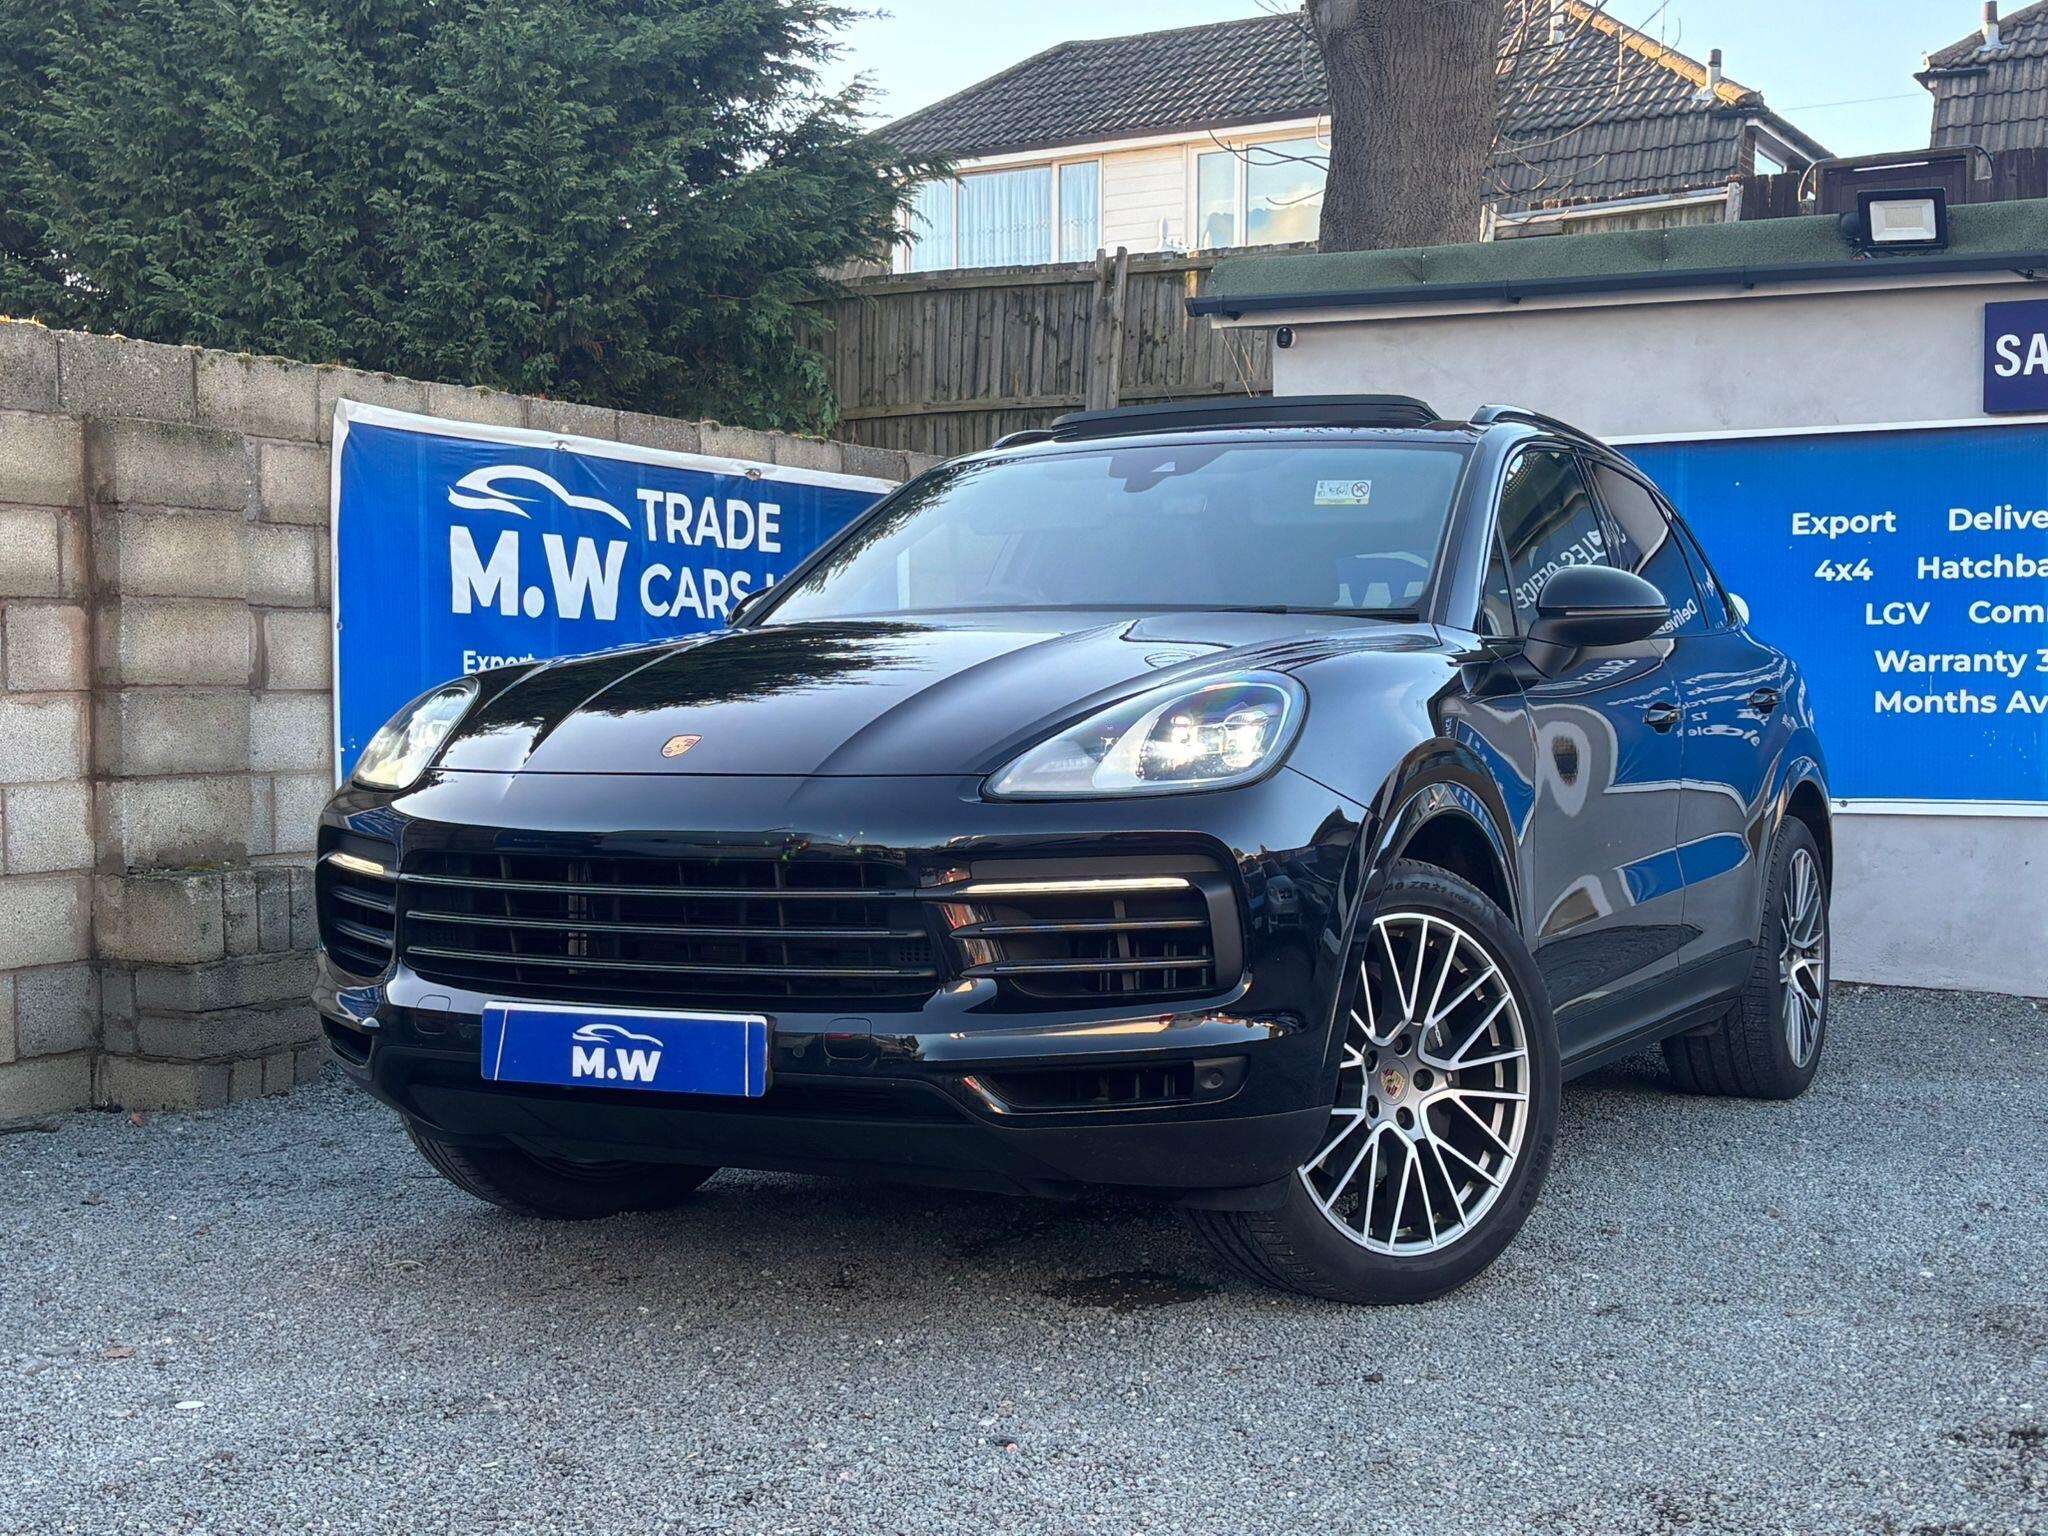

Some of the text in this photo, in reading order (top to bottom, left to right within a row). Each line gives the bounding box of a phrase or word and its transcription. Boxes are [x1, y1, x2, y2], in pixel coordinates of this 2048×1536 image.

[1994, 332, 2048, 377] SA
[636, 488, 781, 553] TRADE
[1792, 511, 1896, 539] Export
[450, 525, 629, 620] M.W
[1815, 558, 1873, 581] 4x4
[640, 563, 751, 619] CARS
[1866, 600, 2048, 625] LGV Com
[1875, 650, 2027, 678] Warranty
[1875, 689, 2048, 713] Months Av
[572, 1045, 662, 1082] M.W
